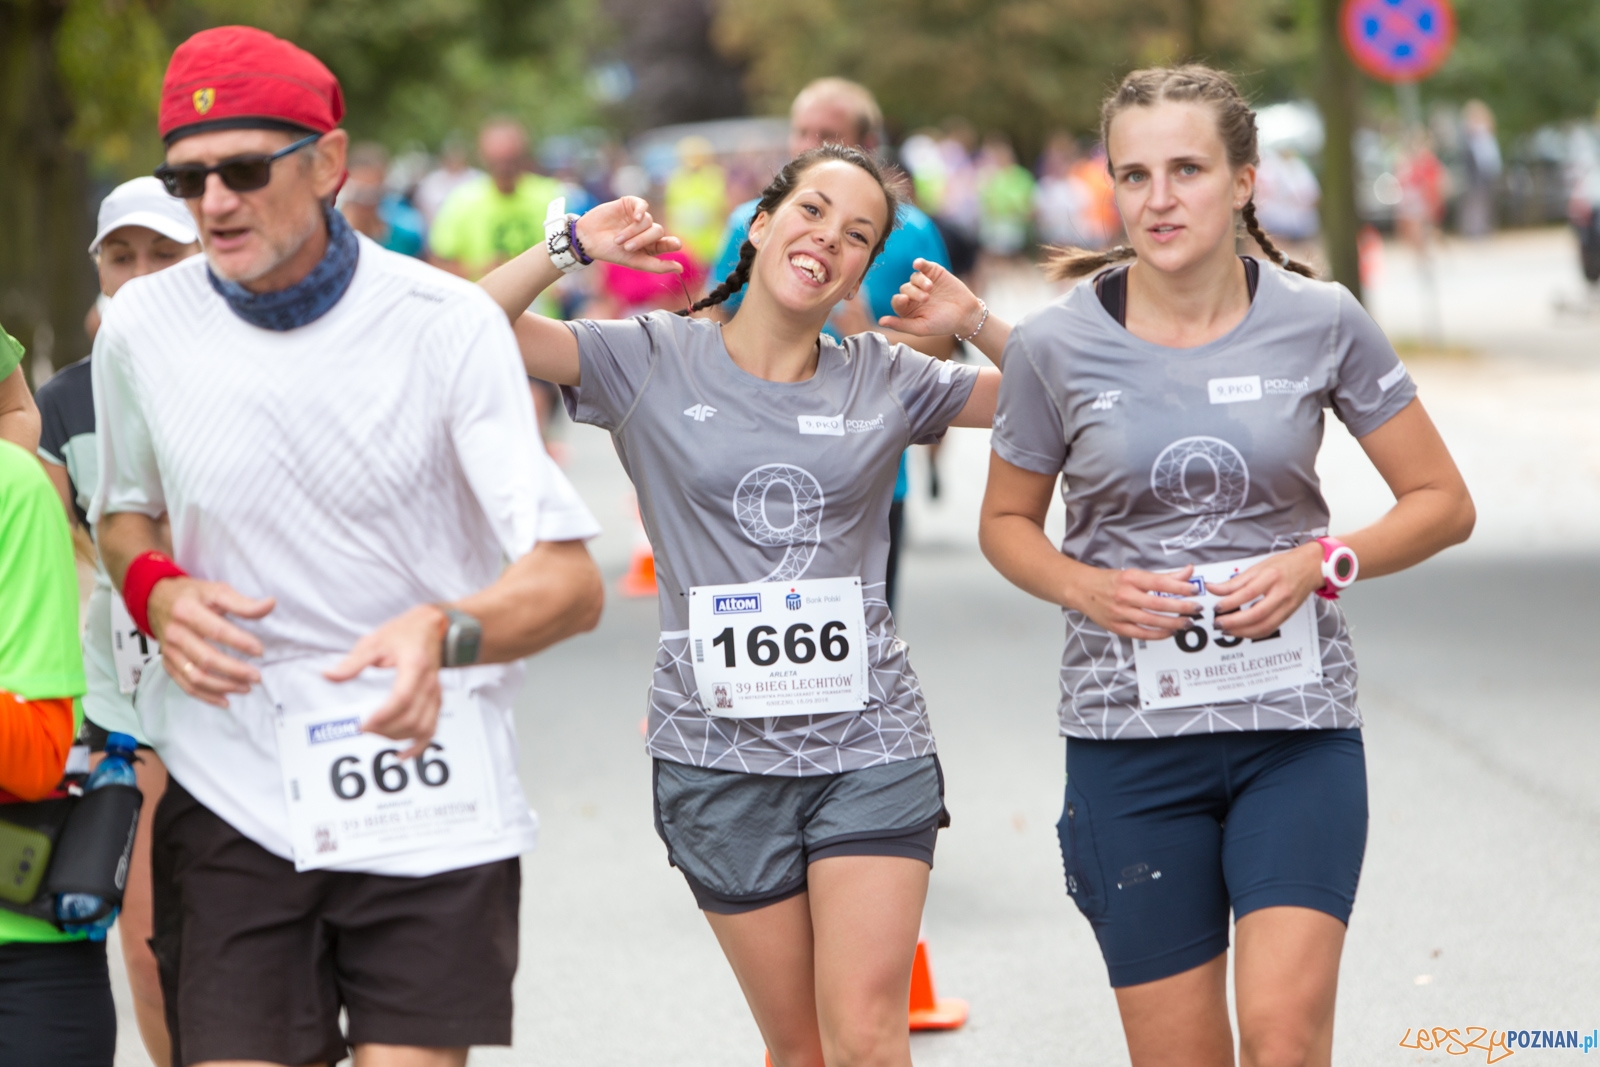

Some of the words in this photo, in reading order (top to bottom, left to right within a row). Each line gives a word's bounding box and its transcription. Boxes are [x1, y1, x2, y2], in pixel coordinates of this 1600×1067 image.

[684, 403, 718, 422] 4F
[1092, 390, 1122, 410] 4F
[1151, 436, 1249, 555] 9
[733, 463, 825, 583] 9
[806, 596, 822, 604] Bank
[713, 620, 849, 668] 1666
[769, 670, 798, 678] ARLETA
[1183, 668, 1200, 680] 39
[1204, 662, 1237, 678] BIEG
[1241, 647, 1303, 672] LECHITÓW
[736, 683, 751, 694] 39
[756, 680, 787, 692] BIEG
[792, 674, 853, 690] LECHITÓW
[331, 742, 450, 800] 666
